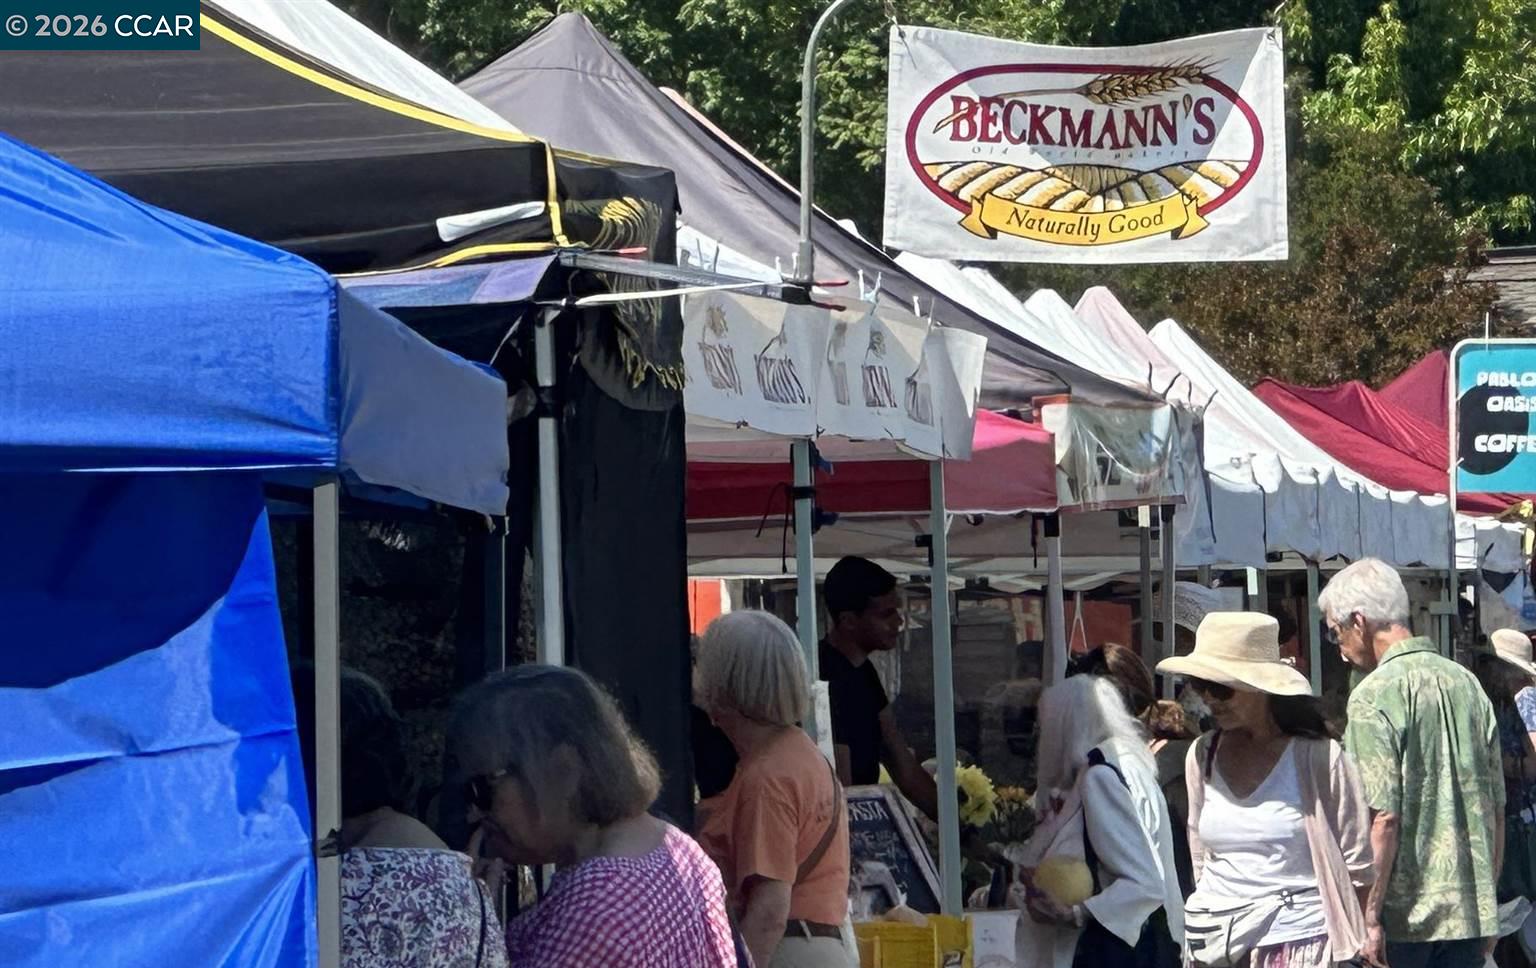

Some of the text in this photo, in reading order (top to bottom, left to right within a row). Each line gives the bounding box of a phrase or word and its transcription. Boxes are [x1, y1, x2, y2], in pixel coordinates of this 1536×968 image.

[949, 94, 1217, 150] BECKMANN'S
[1005, 205, 1165, 242] Naturally Good
